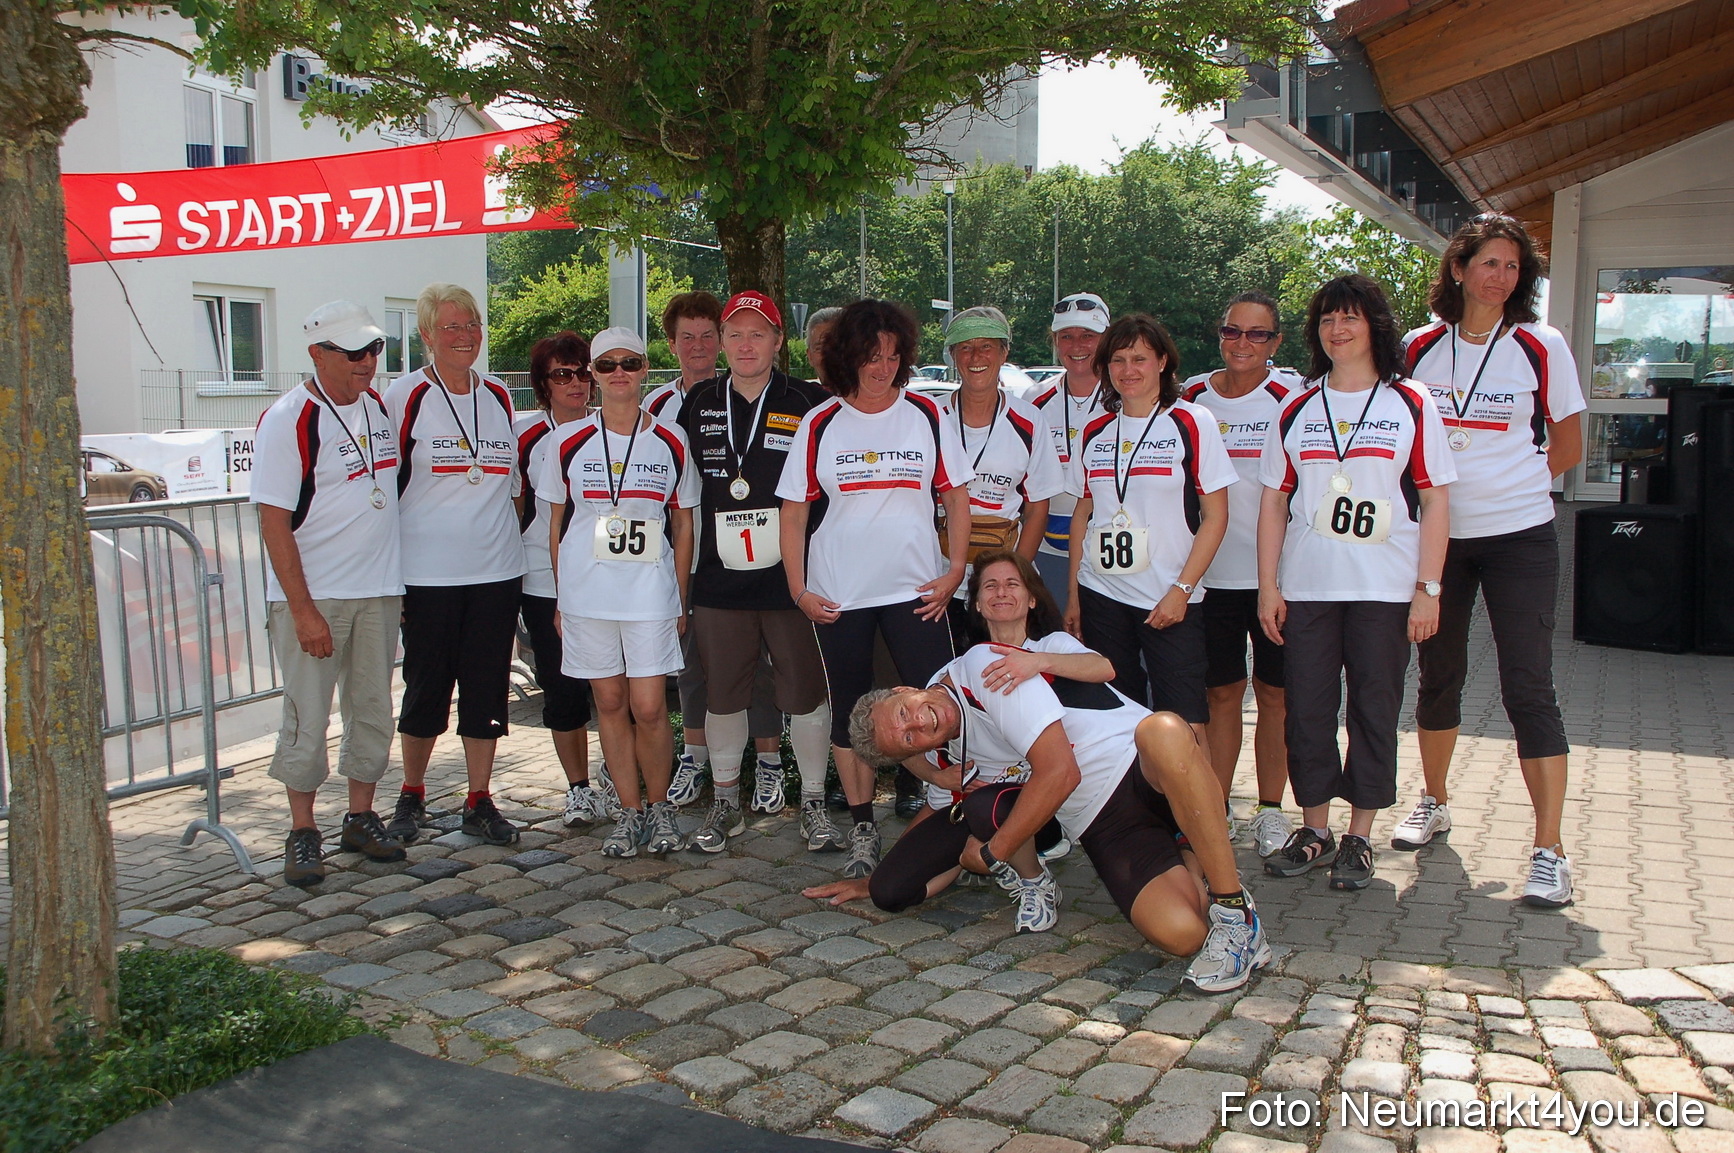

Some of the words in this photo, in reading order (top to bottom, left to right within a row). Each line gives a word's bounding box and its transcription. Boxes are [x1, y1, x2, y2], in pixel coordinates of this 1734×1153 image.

[725, 513, 754, 522] MEYER
[1331, 496, 1376, 539] 66
[740, 528, 755, 562] 1
[1100, 530, 1134, 569] 58
